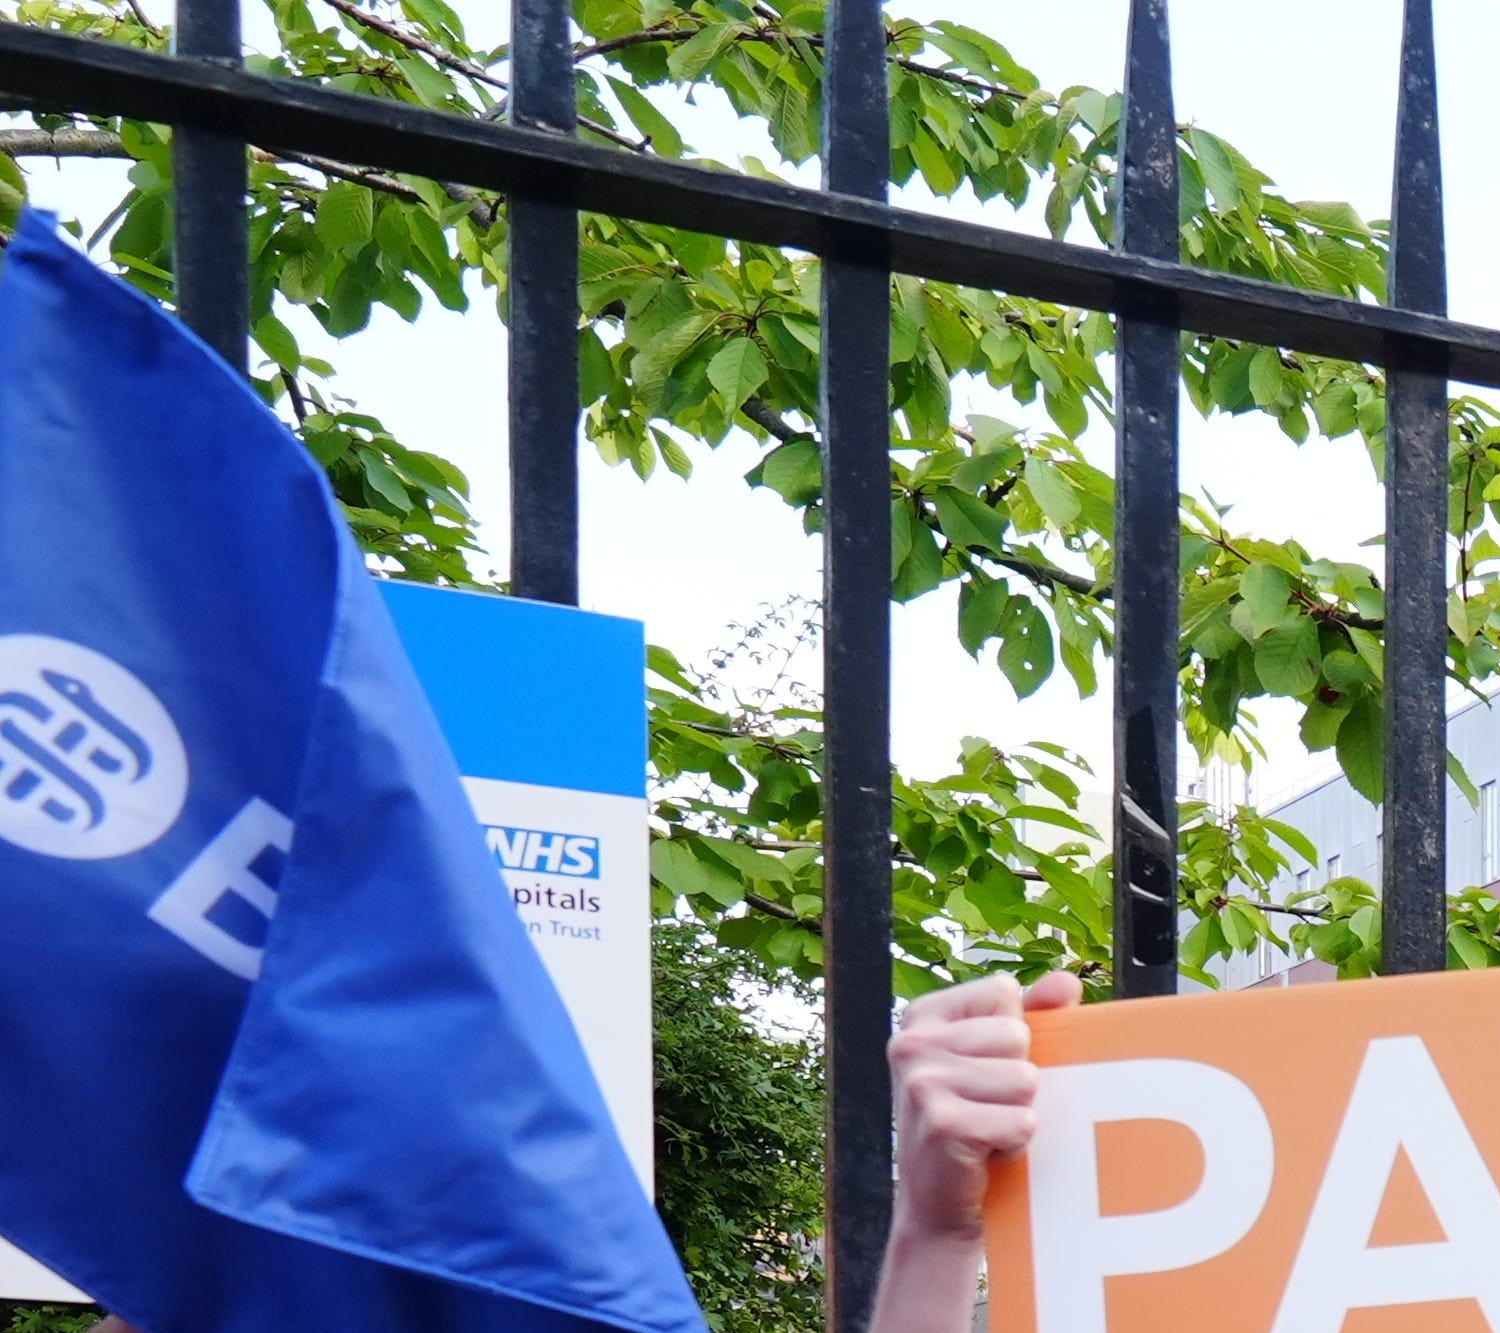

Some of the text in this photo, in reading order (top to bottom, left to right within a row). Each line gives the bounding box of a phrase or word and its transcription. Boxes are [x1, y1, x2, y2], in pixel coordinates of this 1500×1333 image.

[486, 827, 597, 876] NHS
[513, 884, 601, 913] pitals
[550, 920, 602, 941] Trust
